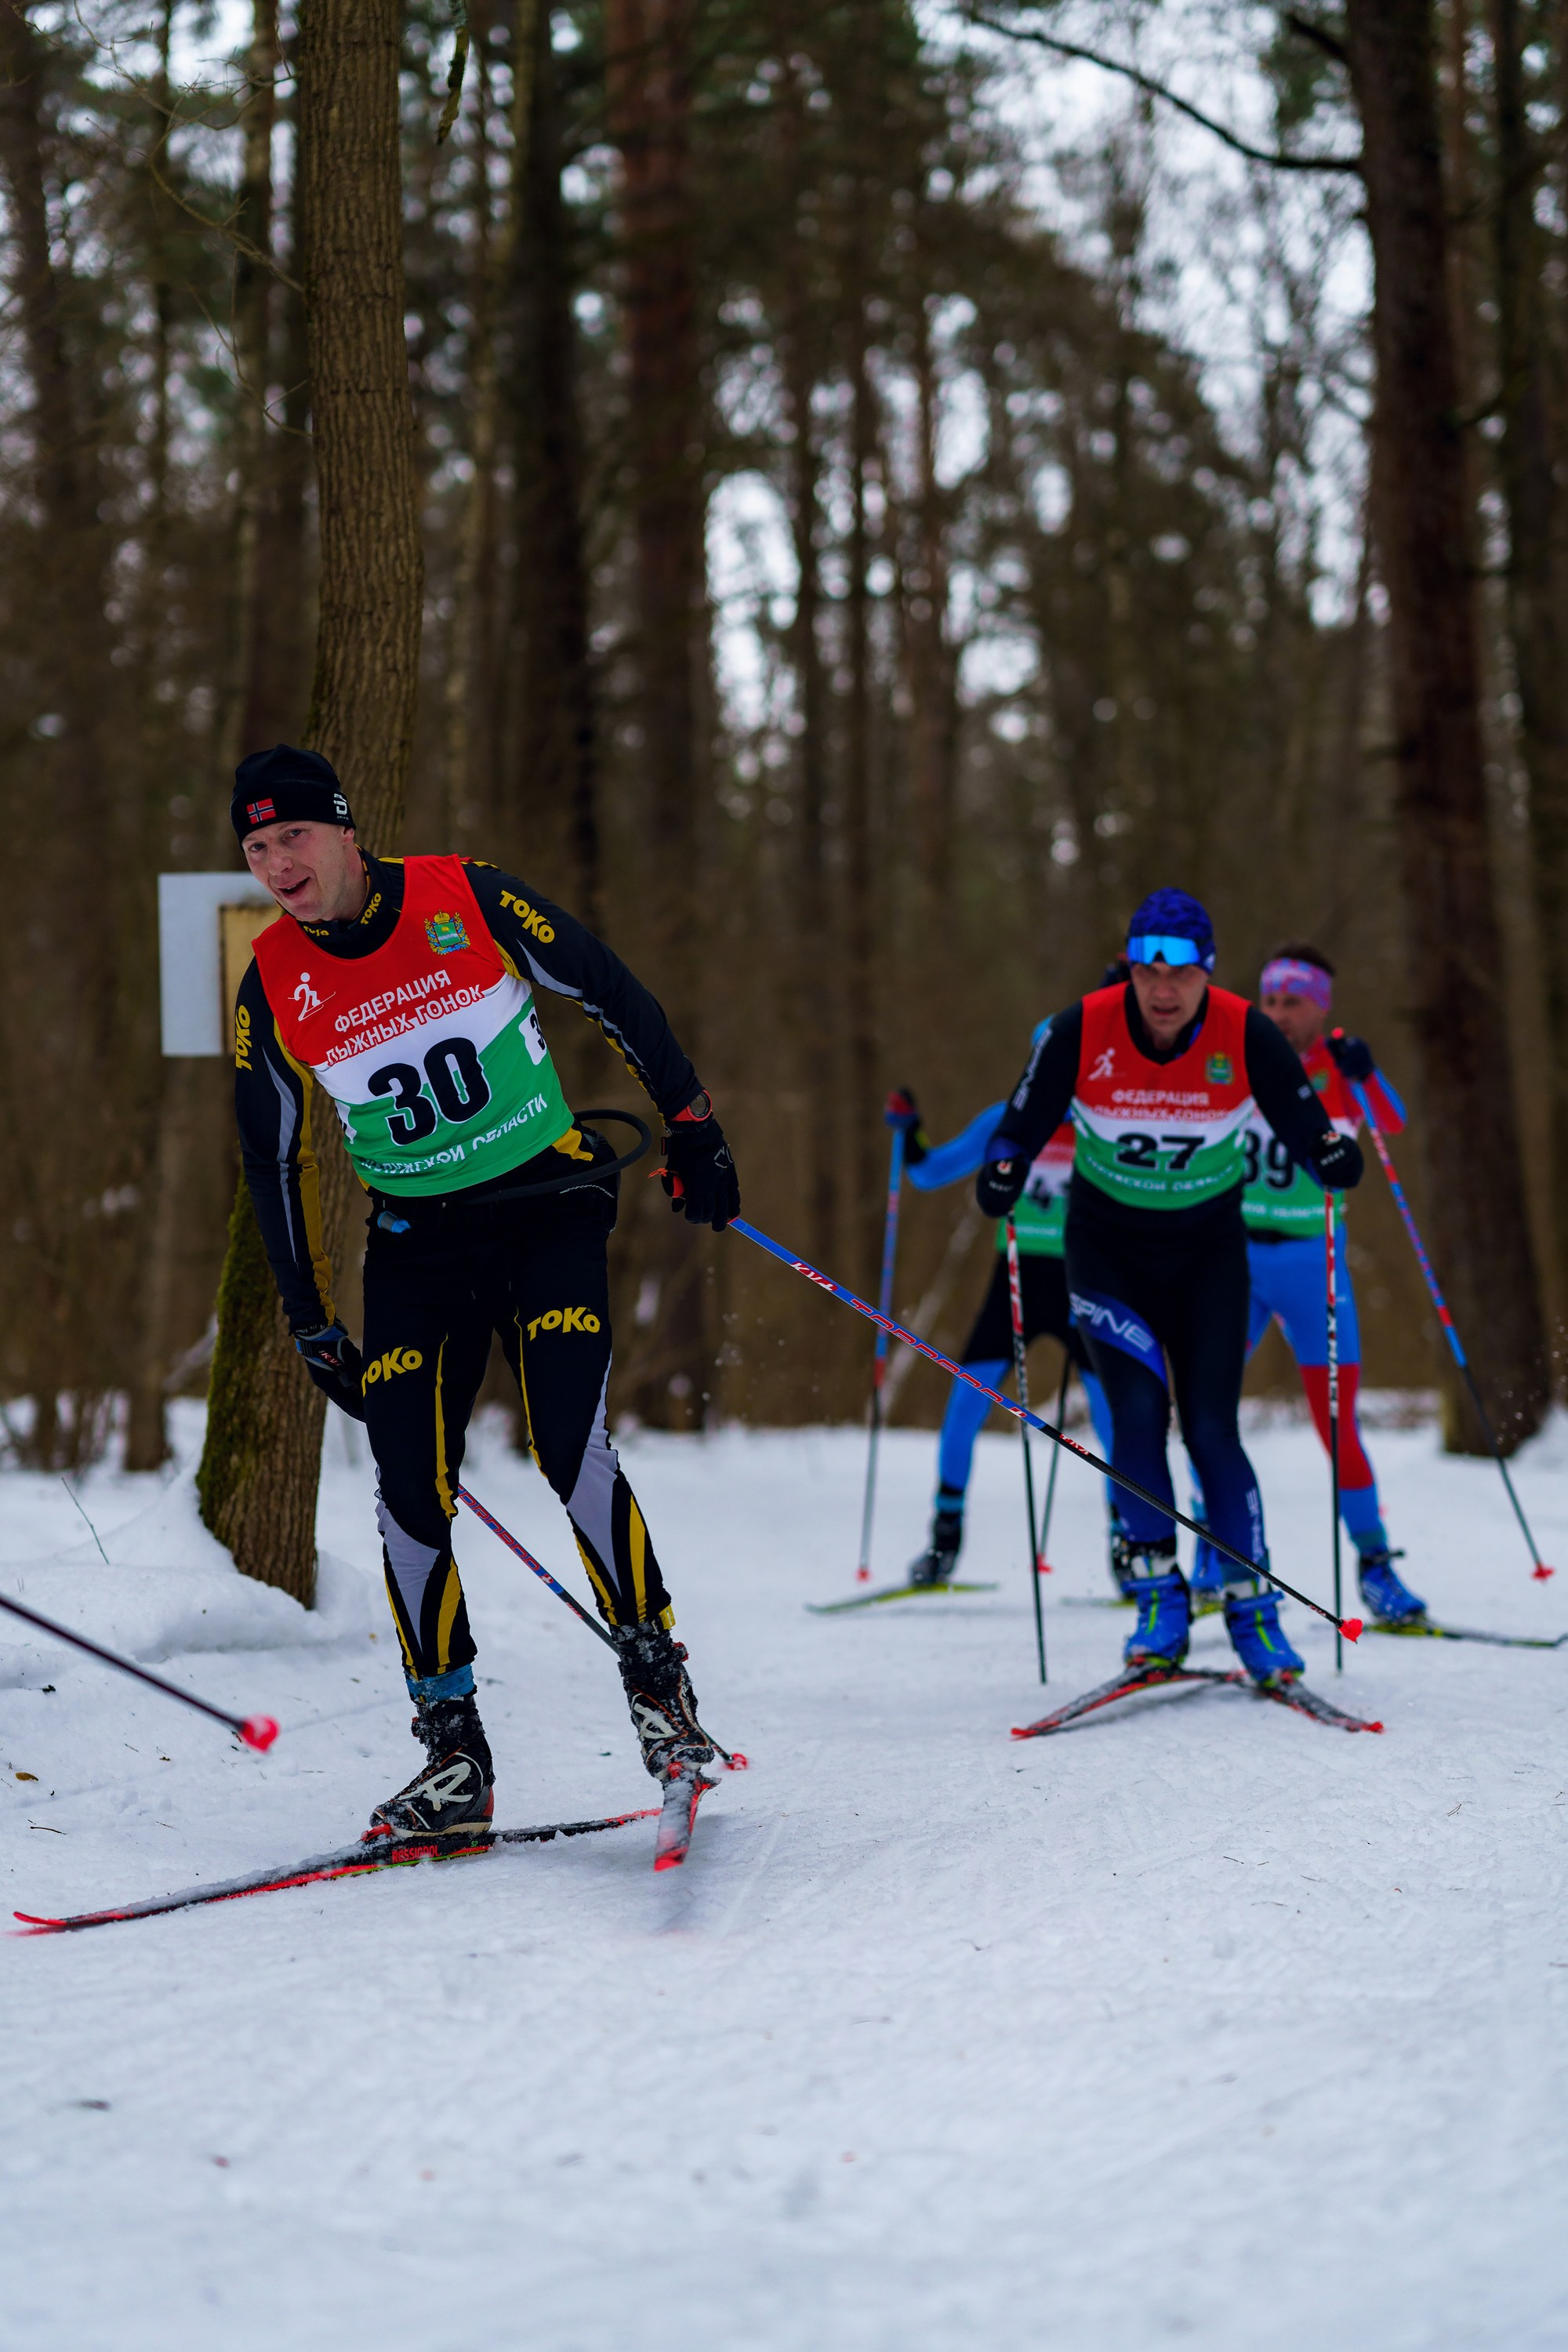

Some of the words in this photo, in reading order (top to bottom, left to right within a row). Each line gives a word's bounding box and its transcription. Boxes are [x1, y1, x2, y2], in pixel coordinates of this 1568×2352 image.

[361, 893, 382, 924] TOKO
[499, 890, 555, 943] TOKO
[335, 969, 452, 1033] ФЕДЕРАЦИЯ
[414, 984, 484, 1024] ГОНОК
[235, 1005, 252, 1071] TOKO
[367, 1036, 492, 1146] 30
[1111, 1088, 1210, 1106] ФЕДЕРАЦИЯ
[1116, 1132, 1206, 1171] 27
[527, 1306, 601, 1341] TOKO
